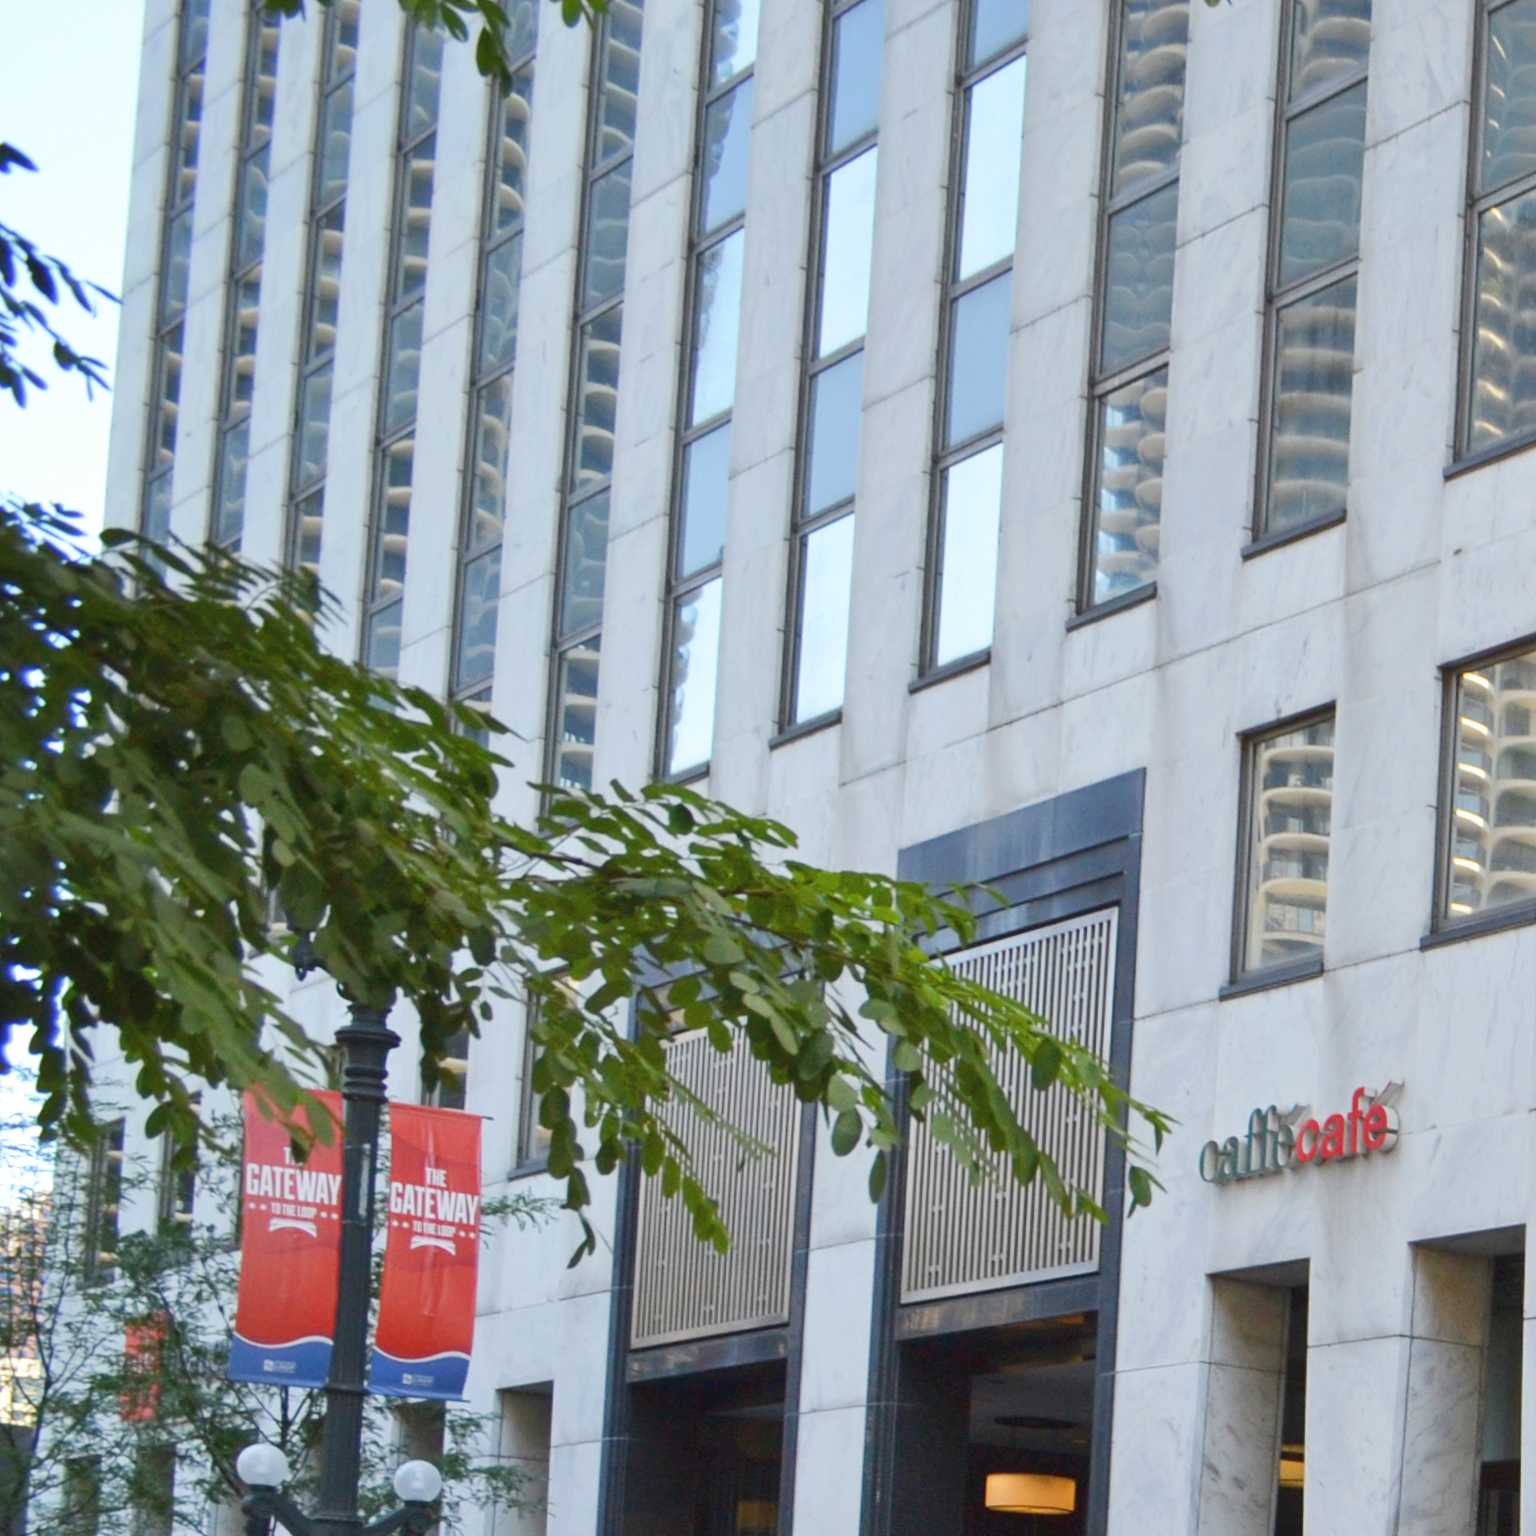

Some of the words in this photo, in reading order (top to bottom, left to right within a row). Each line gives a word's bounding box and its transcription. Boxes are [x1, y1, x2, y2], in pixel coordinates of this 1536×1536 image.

[246, 1162, 343, 1206] GATEWAY
[425, 1166, 448, 1188] THE
[390, 1181, 480, 1225] GATEWAY
